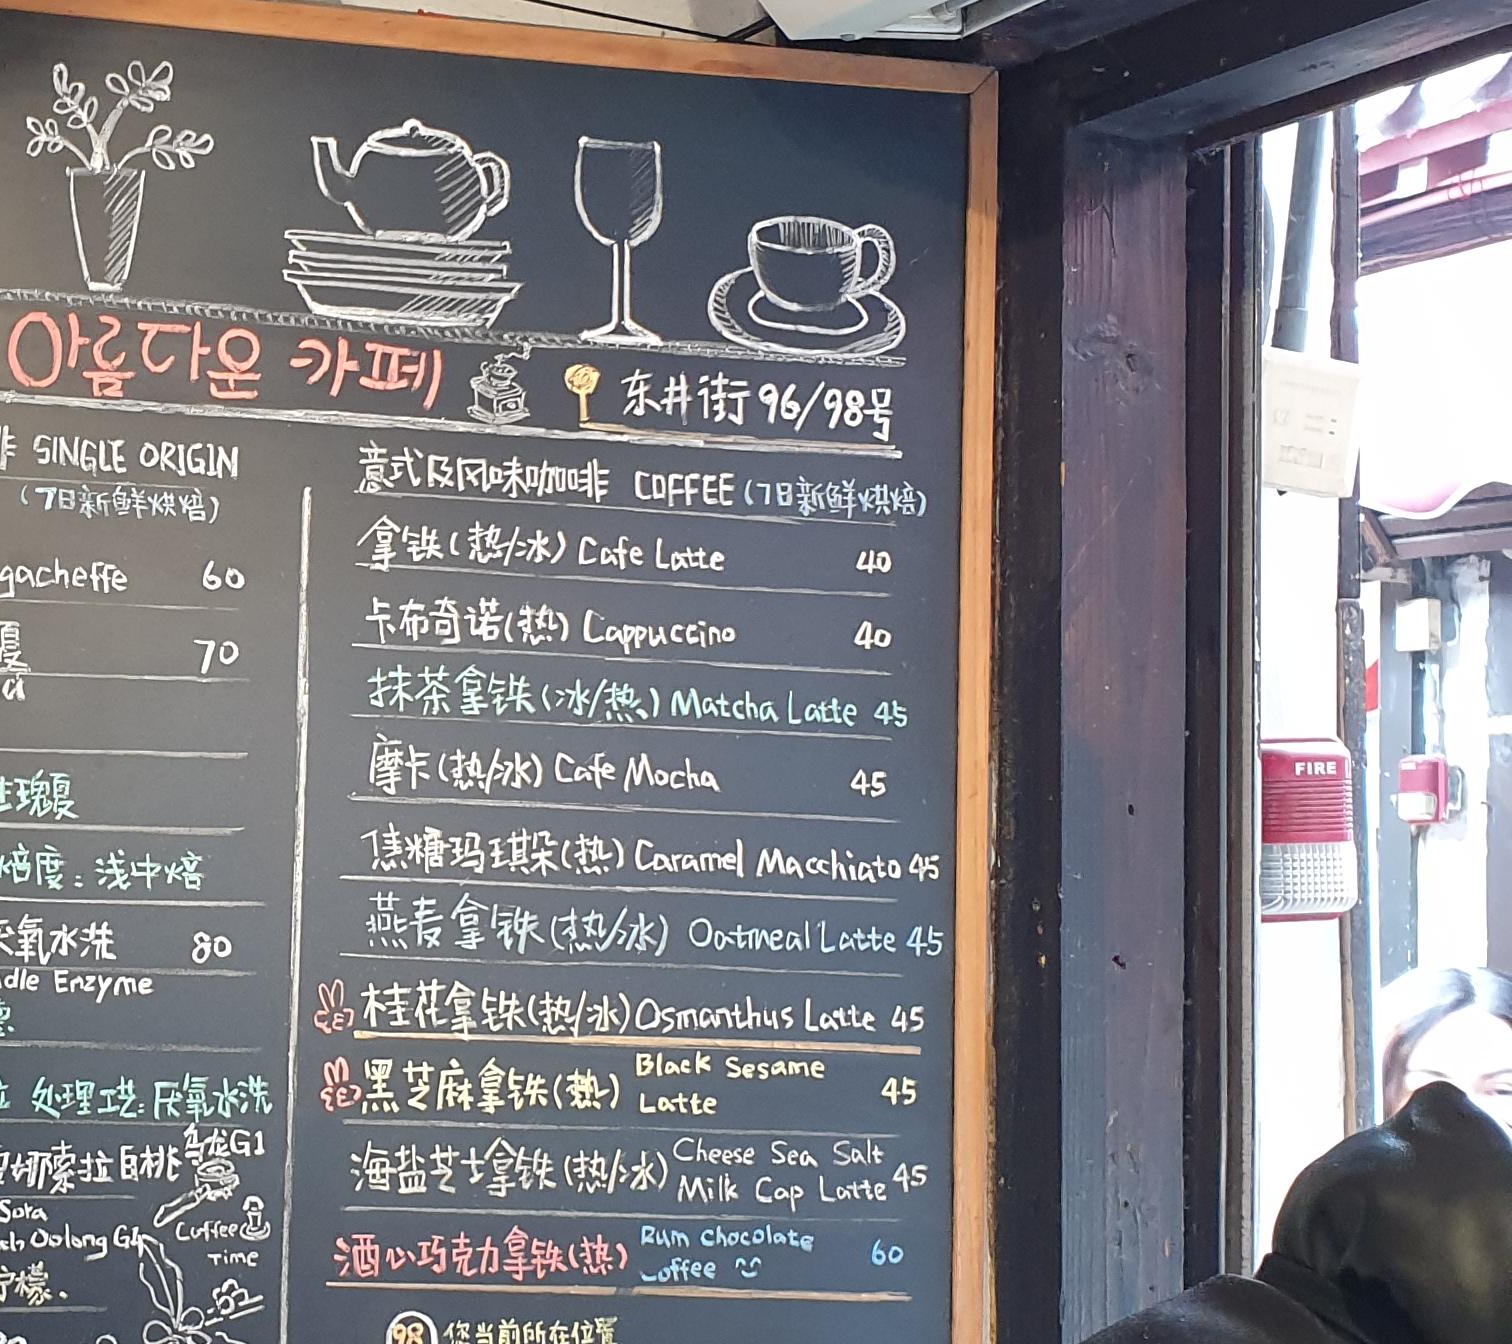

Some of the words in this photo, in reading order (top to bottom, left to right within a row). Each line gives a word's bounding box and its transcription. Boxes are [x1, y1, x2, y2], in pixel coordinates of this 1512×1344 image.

[7, 310, 262, 400] 아름다운
[291, 336, 444, 409] 카페
[32, 437, 128, 476] SINGLE
[138, 441, 240, 480] ORIGIN
[355, 441, 610, 496] 意式及风味咖啡
[634, 470, 736, 508] COFFEE
[578, 535, 643, 569] Cafe
[655, 538, 725, 572] Latte
[855, 549, 892, 574] 40
[201, 559, 246, 591] 60
[583, 609, 736, 655] Cappuccino
[854, 620, 892, 649] 40
[193, 638, 240, 675] 70
[671, 687, 779, 723] Matcha
[788, 690, 857, 727] Latte
[873, 700, 908, 727] 45
[554, 751, 616, 789] Cafe
[624, 752, 720, 793] Mocha
[850, 768, 887, 797] 45
[1294, 760, 1338, 777] FIRE
[635, 838, 744, 878] Caramel
[756, 847, 902, 883] Macchiato
[909, 853, 939, 882] 45
[191, 931, 233, 964] 80
[688, 917, 809, 951] Oatmeal
[819, 920, 896, 953] Latte
[906, 926, 944, 956] 45
[53, 969, 154, 1004] Enzyme
[636, 995, 794, 1033] Osmanthus
[805, 998, 876, 1032] Latte
[891, 1005, 925, 1033] 45
[636, 1051, 711, 1077] Black
[725, 1056, 825, 1080] Sesame
[881, 1076, 917, 1105] 45
[639, 1092, 717, 1115] Latte
[673, 1137, 755, 1166] Cheese
[771, 1140, 818, 1168] Sea
[833, 1138, 885, 1166] Salt
[677, 1173, 739, 1204] Milk
[755, 1176, 804, 1212] Cap
[819, 1176, 887, 1203] Latte
[892, 1162, 928, 1193] 45
[640, 1224, 689, 1249] Rum
[871, 1239, 904, 1266] 60
